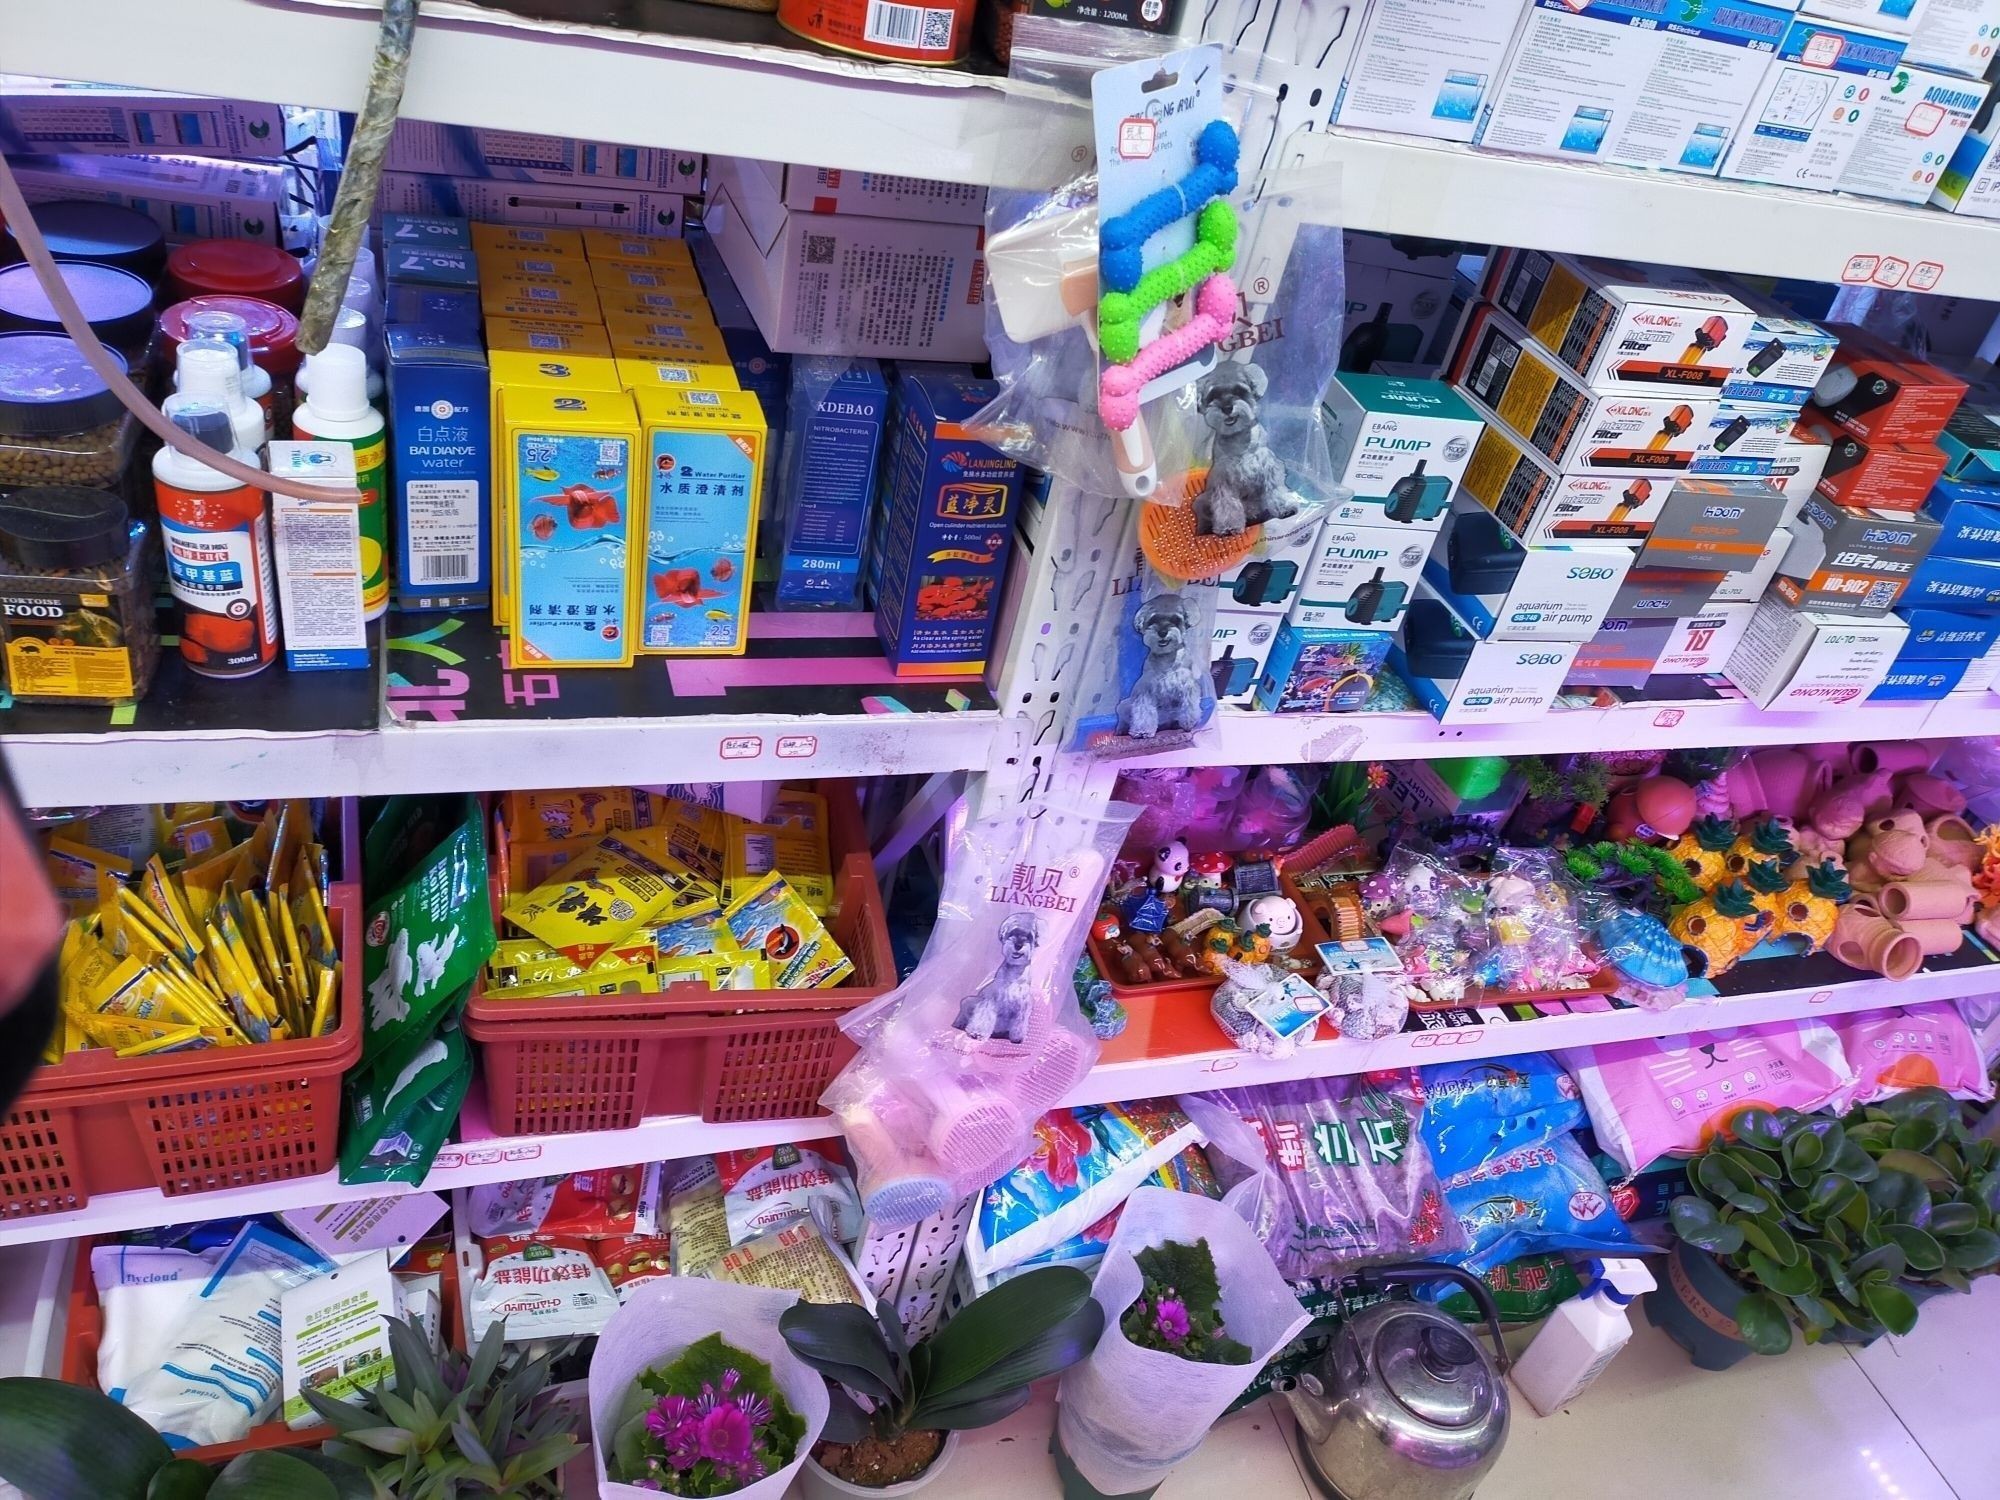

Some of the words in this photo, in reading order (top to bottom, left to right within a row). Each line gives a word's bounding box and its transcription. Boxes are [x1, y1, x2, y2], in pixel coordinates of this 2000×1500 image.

[1922, 85, 1982, 111] AQUARIUM
[395, 223, 458, 238] NO.7
[399, 256, 466, 271] NO.7
[1624, 330, 1675, 344] Internal
[1618, 340, 1652, 351] Filter
[1664, 369, 1704, 380] XL-F008
[1739, 387, 1764, 397] SUPER
[1381, 394, 1443, 404] PUMP
[816, 401, 874, 416] KDEBAO
[813, 425, 869, 435] NITROBACTERIA
[1371, 422, 1398, 432] EBANG
[1597, 421, 1645, 432] Internal
[418, 426, 469, 443] 白点液
[1592, 430, 1623, 439] Filter
[1364, 436, 1431, 451] PUMP
[409, 446, 430, 456] BAI
[432, 446, 476, 456] DIANYE
[421, 457, 464, 469] water
[968, 458, 1017, 469] LANJINGLING
[1634, 455, 1669, 465] XL-F008
[1706, 460, 1731, 470] SUPER
[659, 482, 744, 497] 水质澄清剂
[943, 493, 997, 515] 蓝净灵
[1560, 495, 1606, 504] Internal
[1554, 504, 1584, 513] Filter
[1595, 526, 1629, 535] XL-F008
[1332, 534, 1356, 543] EBANG
[1325, 547, 1388, 560] PUMP
[802, 558, 841, 570] 280ml
[172, 561, 235, 583] 亚甲基蓝
[1822, 577, 1871, 594] HD-802
[1926, 581, 1986, 599] 高级活性炭
[0, 596, 62, 606] TORTOISE
[1515, 600, 1563, 613] aquarium
[2, 604, 64, 618] FOOD
[528, 603, 616, 616] 水质澄清剂
[1542, 612, 1557, 622] air
[1559, 612, 1593, 624] pump
[711, 625, 730, 636] 25
[1825, 636, 1856, 644] QL-707
[227, 653, 258, 665] 300ml
[1467, 685, 1514, 697] aquarium
[1493, 694, 1508, 704] air
[1509, 696, 1544, 706] pump
[1405, 776, 1436, 809] LIGHT
[1009, 861, 1064, 896] 靓贝
[990, 884, 1078, 914] LIANGBEI
[1769, 1067, 1794, 1084] 10kg
[744, 1167, 834, 1202] 特效功能盐
[493, 1263, 591, 1286] 特效功能盐
